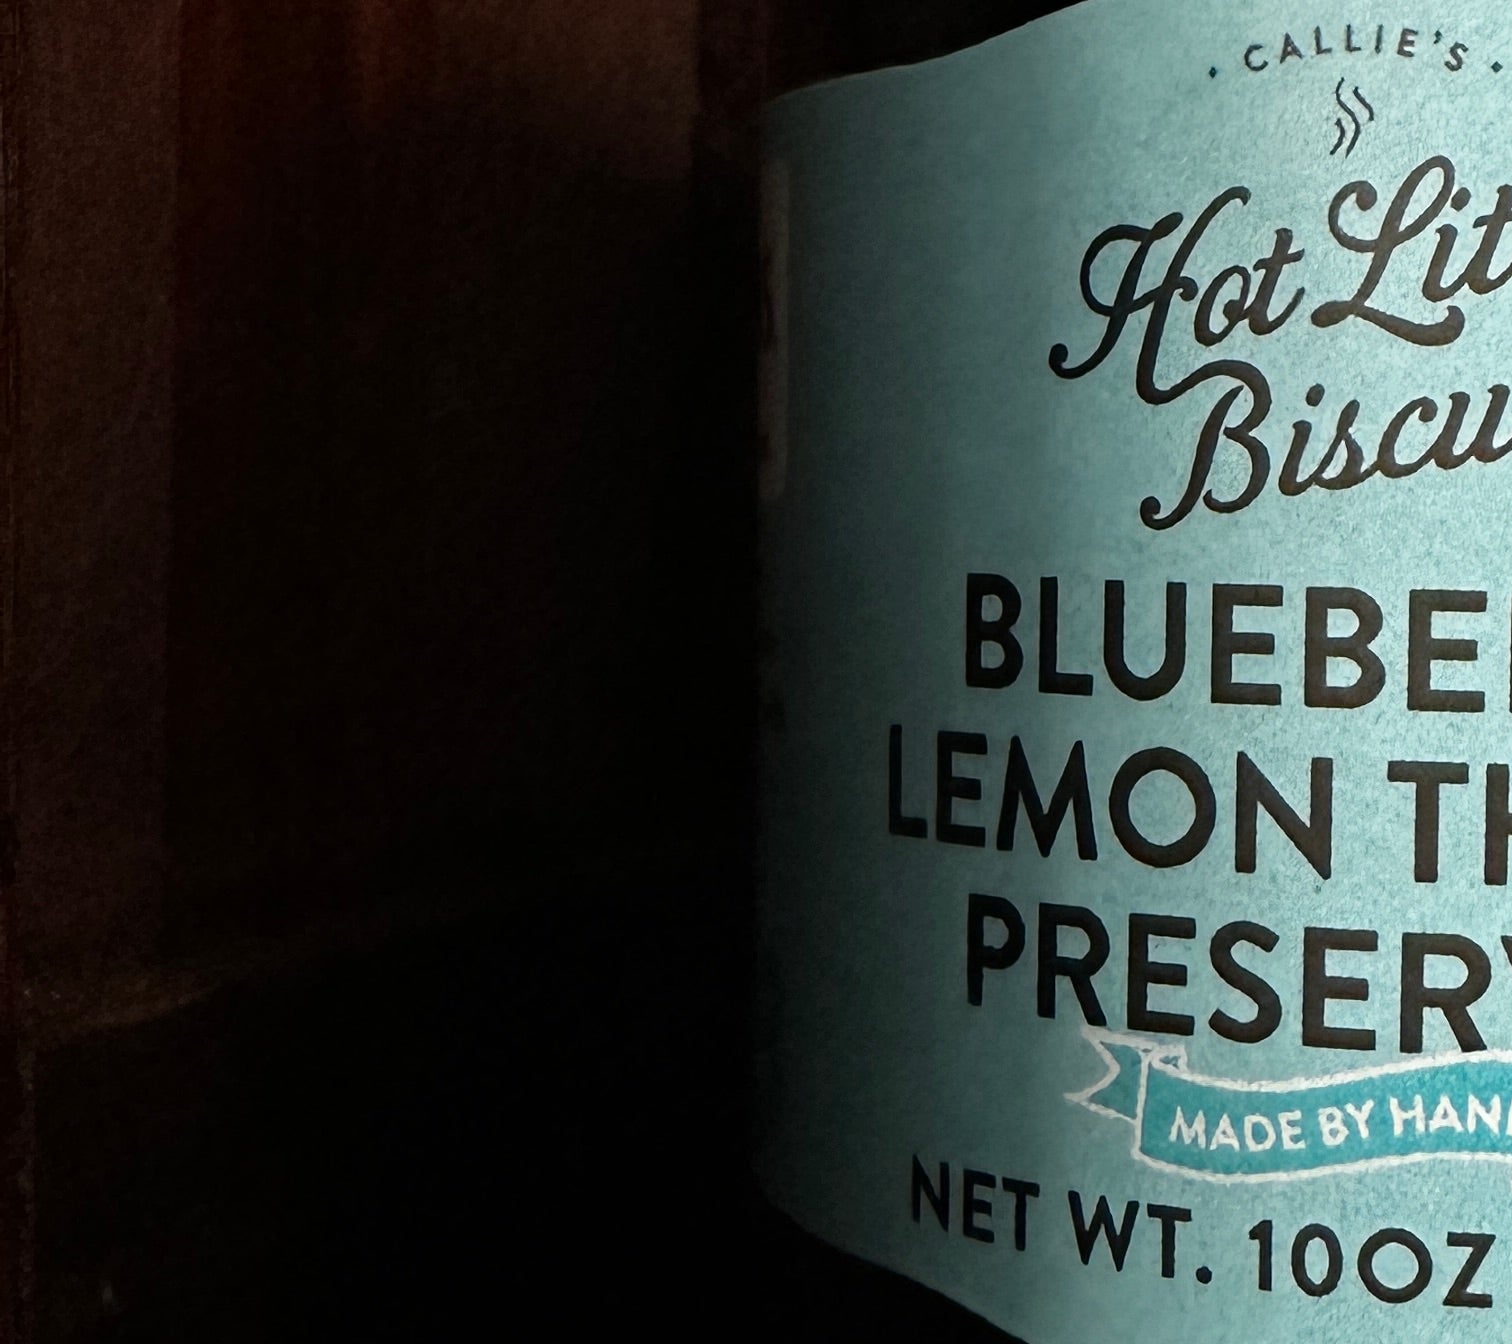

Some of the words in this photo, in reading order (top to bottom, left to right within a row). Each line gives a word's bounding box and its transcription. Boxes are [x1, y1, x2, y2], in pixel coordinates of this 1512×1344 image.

[1242, 24, 1469, 72] CALLIE'S
[1048, 186, 1306, 406] Hot
[886, 722, 1335, 882] LEMON
[1168, 1104, 1308, 1154] MADE
[1318, 1099, 1374, 1146] BY
[911, 1152, 1042, 1252] NET
[1066, 1188, 1214, 1286] WT.
[1247, 1221, 1496, 1310] 10OZ
